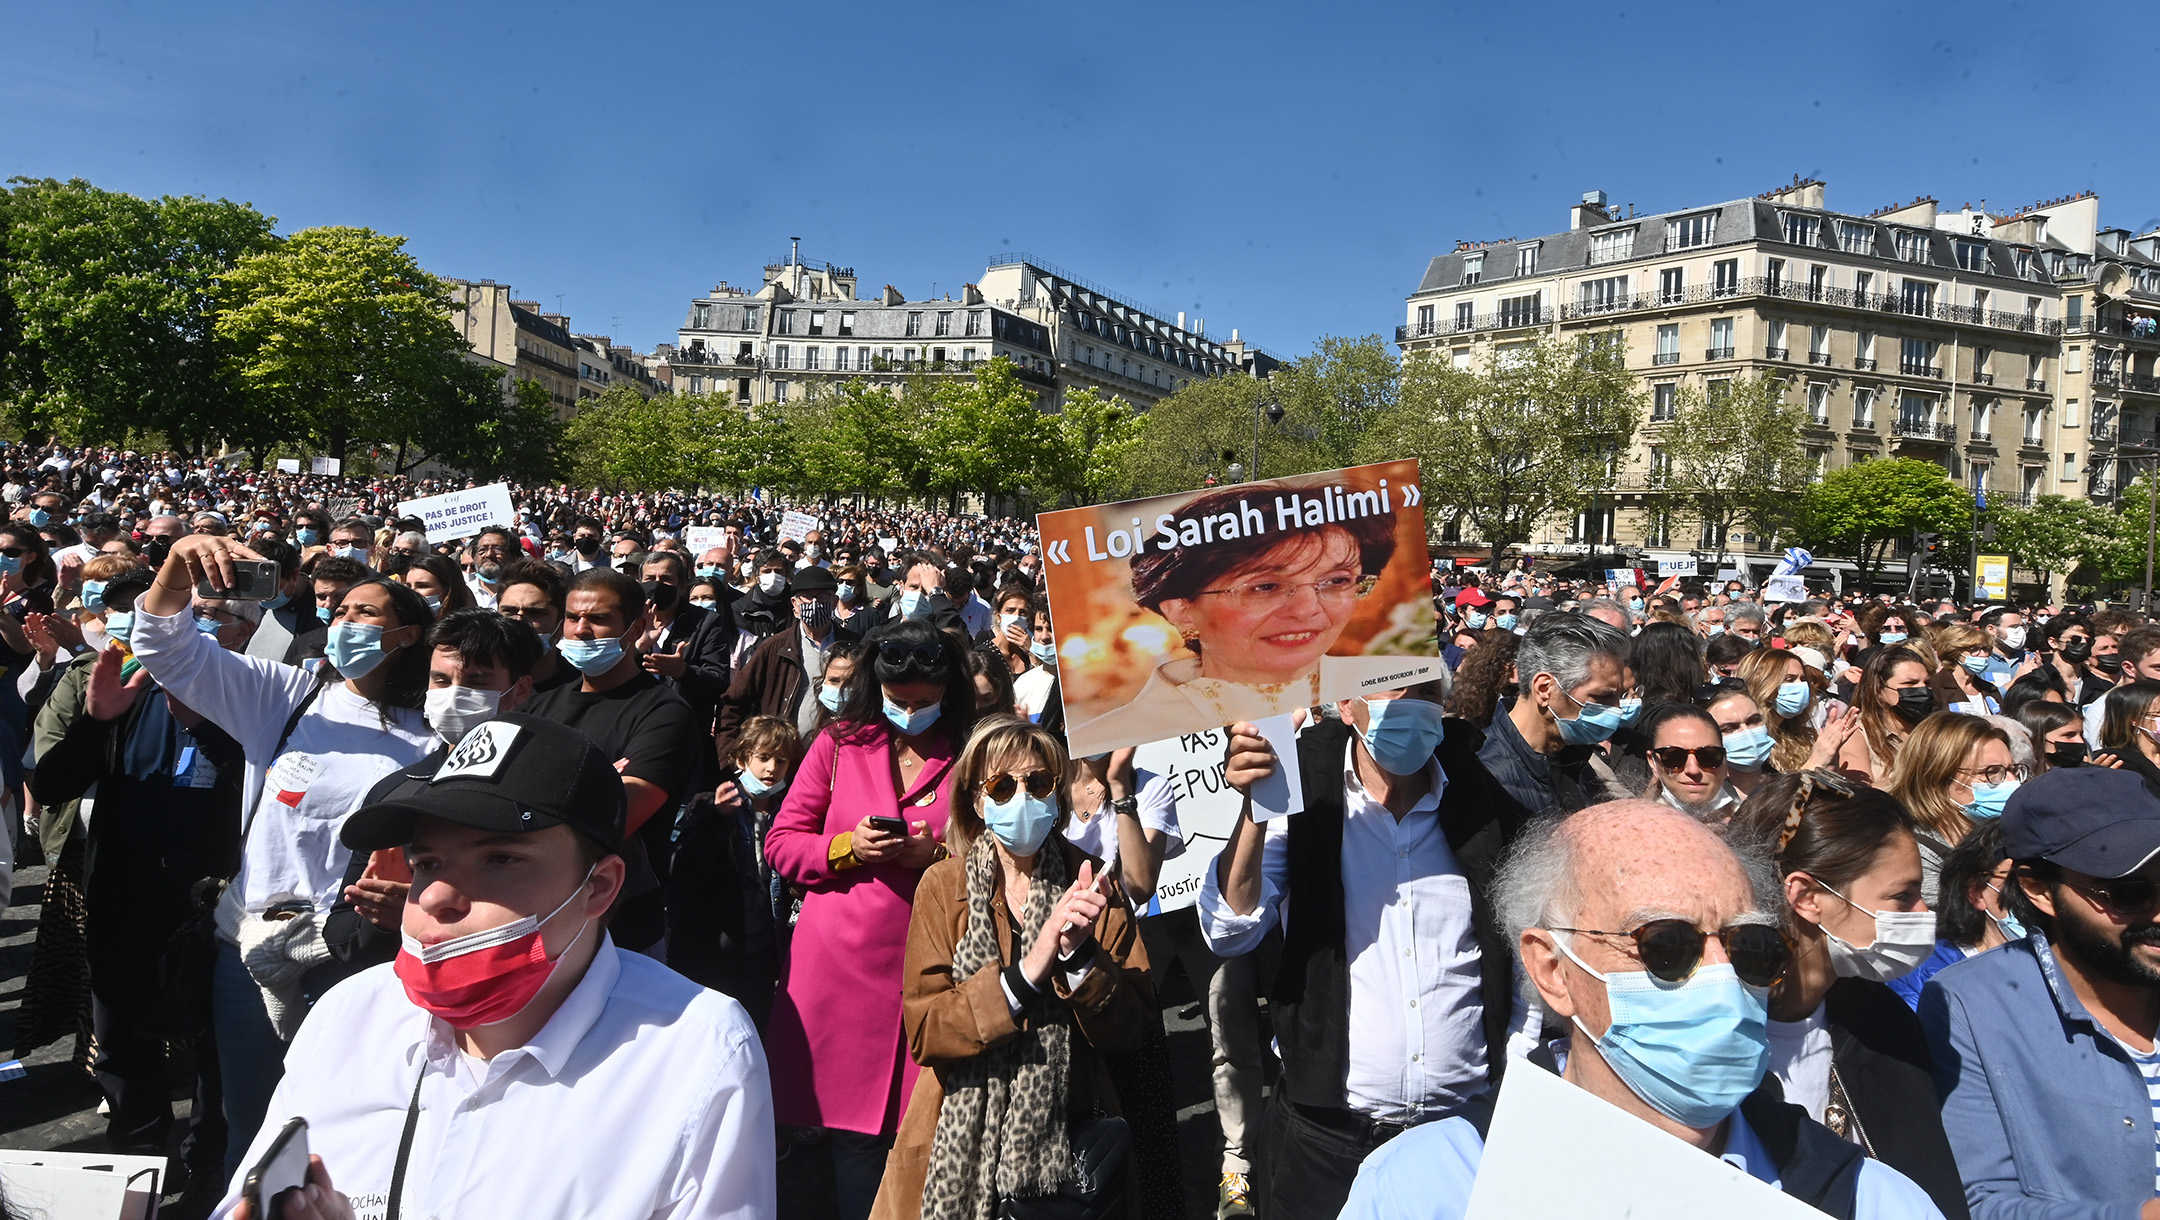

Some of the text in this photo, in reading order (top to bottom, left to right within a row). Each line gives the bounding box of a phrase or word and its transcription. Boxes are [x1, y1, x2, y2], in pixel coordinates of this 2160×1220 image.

[444, 495, 460, 504] Crif
[425, 501, 487, 520] PAS DE DROIT
[424, 521, 447, 532] SANS
[450, 513, 488, 527] JUSTICE
[1085, 518, 1145, 562] Loi
[1156, 500, 1265, 551] Sarah
[1275, 479, 1391, 531] Halimi
[1670, 561, 1696, 570] UEJF
[1361, 679, 1376, 687] LOGE
[1180, 729, 1218, 753] PAS
